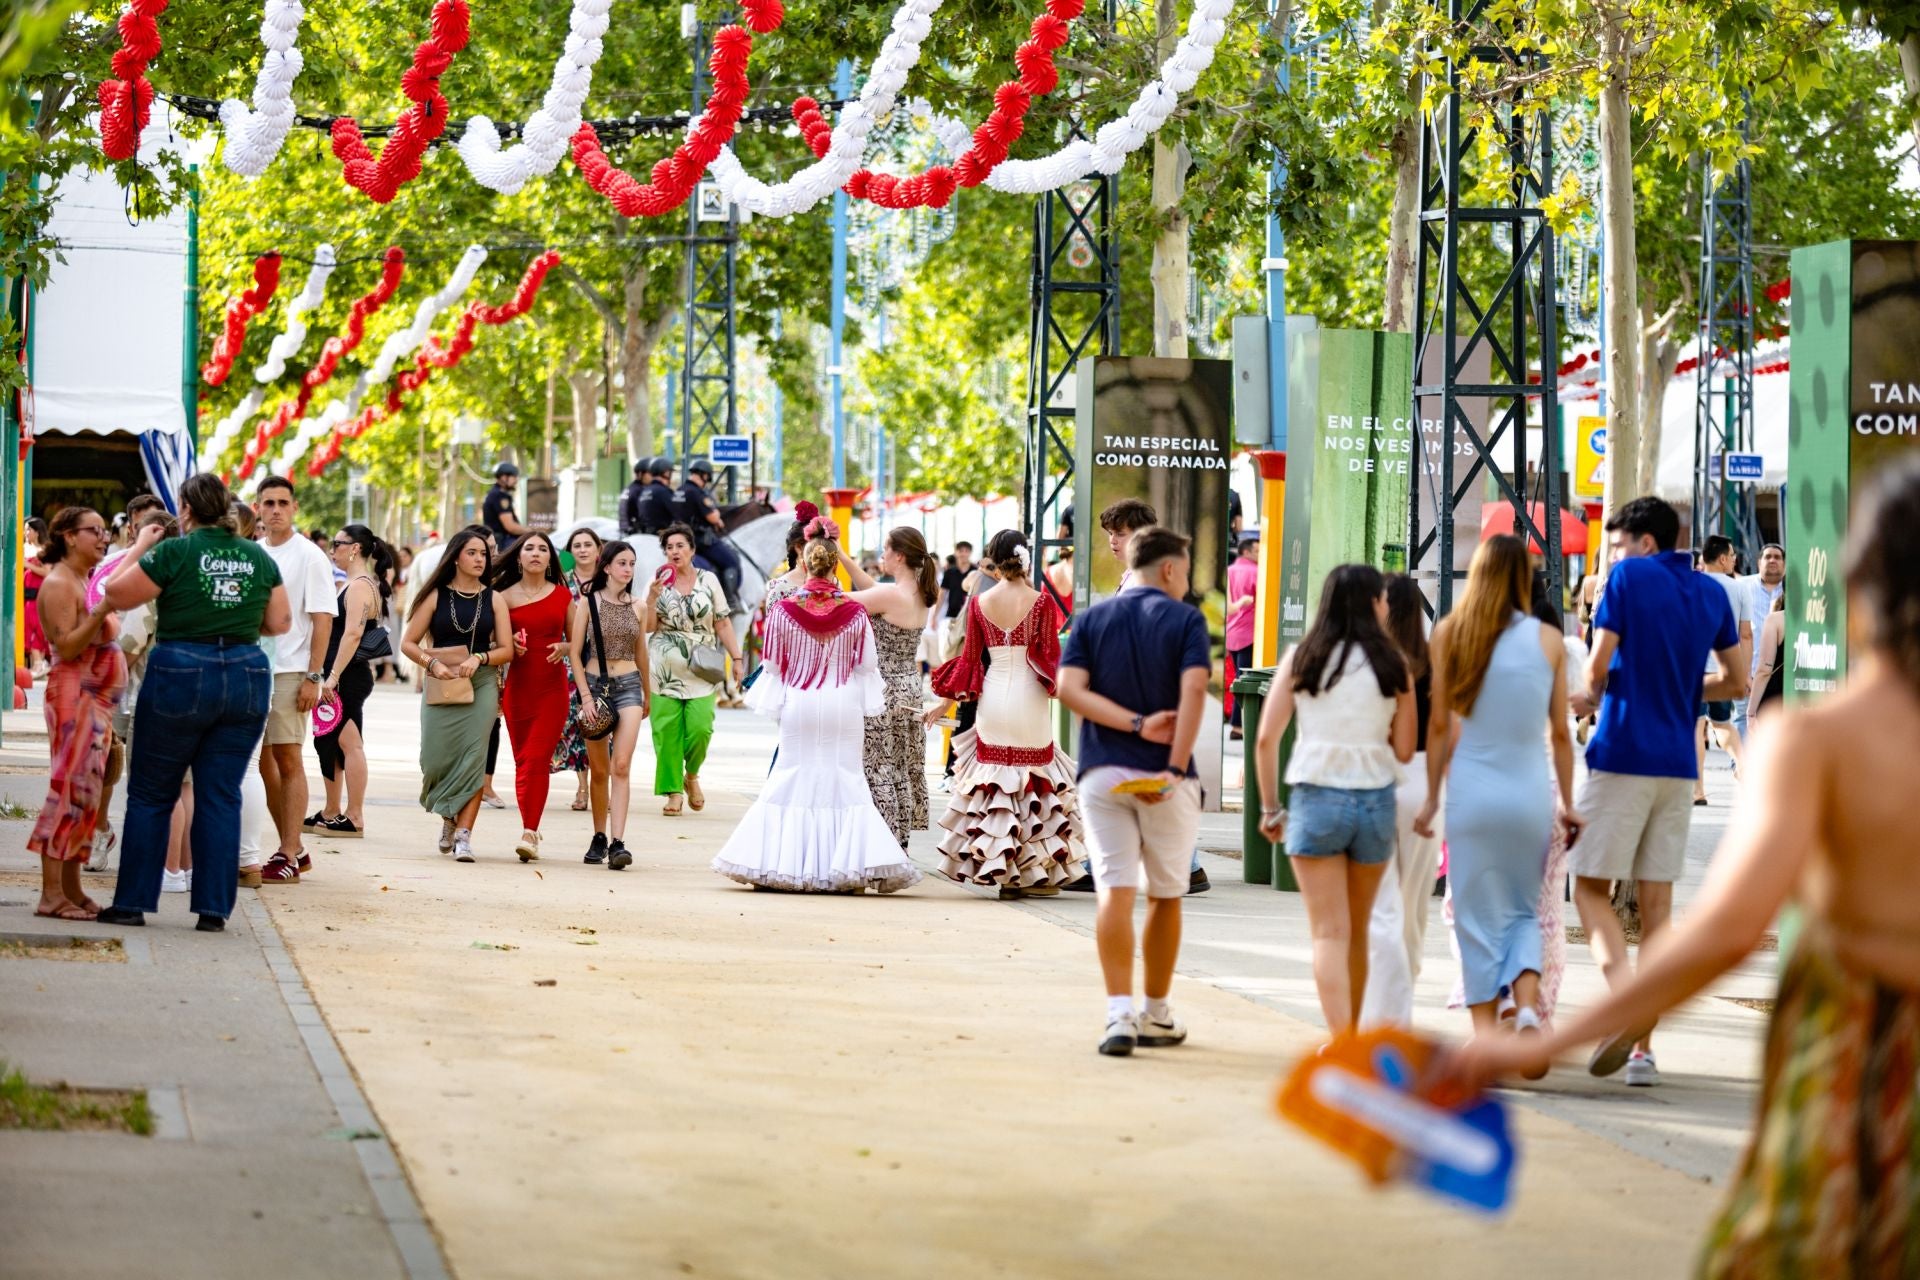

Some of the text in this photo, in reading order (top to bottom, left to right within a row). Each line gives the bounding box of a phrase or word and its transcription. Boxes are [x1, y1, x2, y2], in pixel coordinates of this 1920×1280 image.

[1870, 383, 1920, 404] TAN
[1327, 415, 1469, 434] EN EL CRP
[1855, 414, 1917, 435] COM
[1103, 435, 1220, 451] TAN ESPECIAL
[1324, 435, 1474, 456] NOS VESIMOS
[1095, 453, 1227, 470] COMO GRANADA
[1348, 458, 1443, 475] DE VED
[200, 554, 255, 577] Corpus
[1808, 547, 1827, 588] 100
[1806, 589, 1828, 624] años
[1793, 631, 1837, 672] Alhambra
